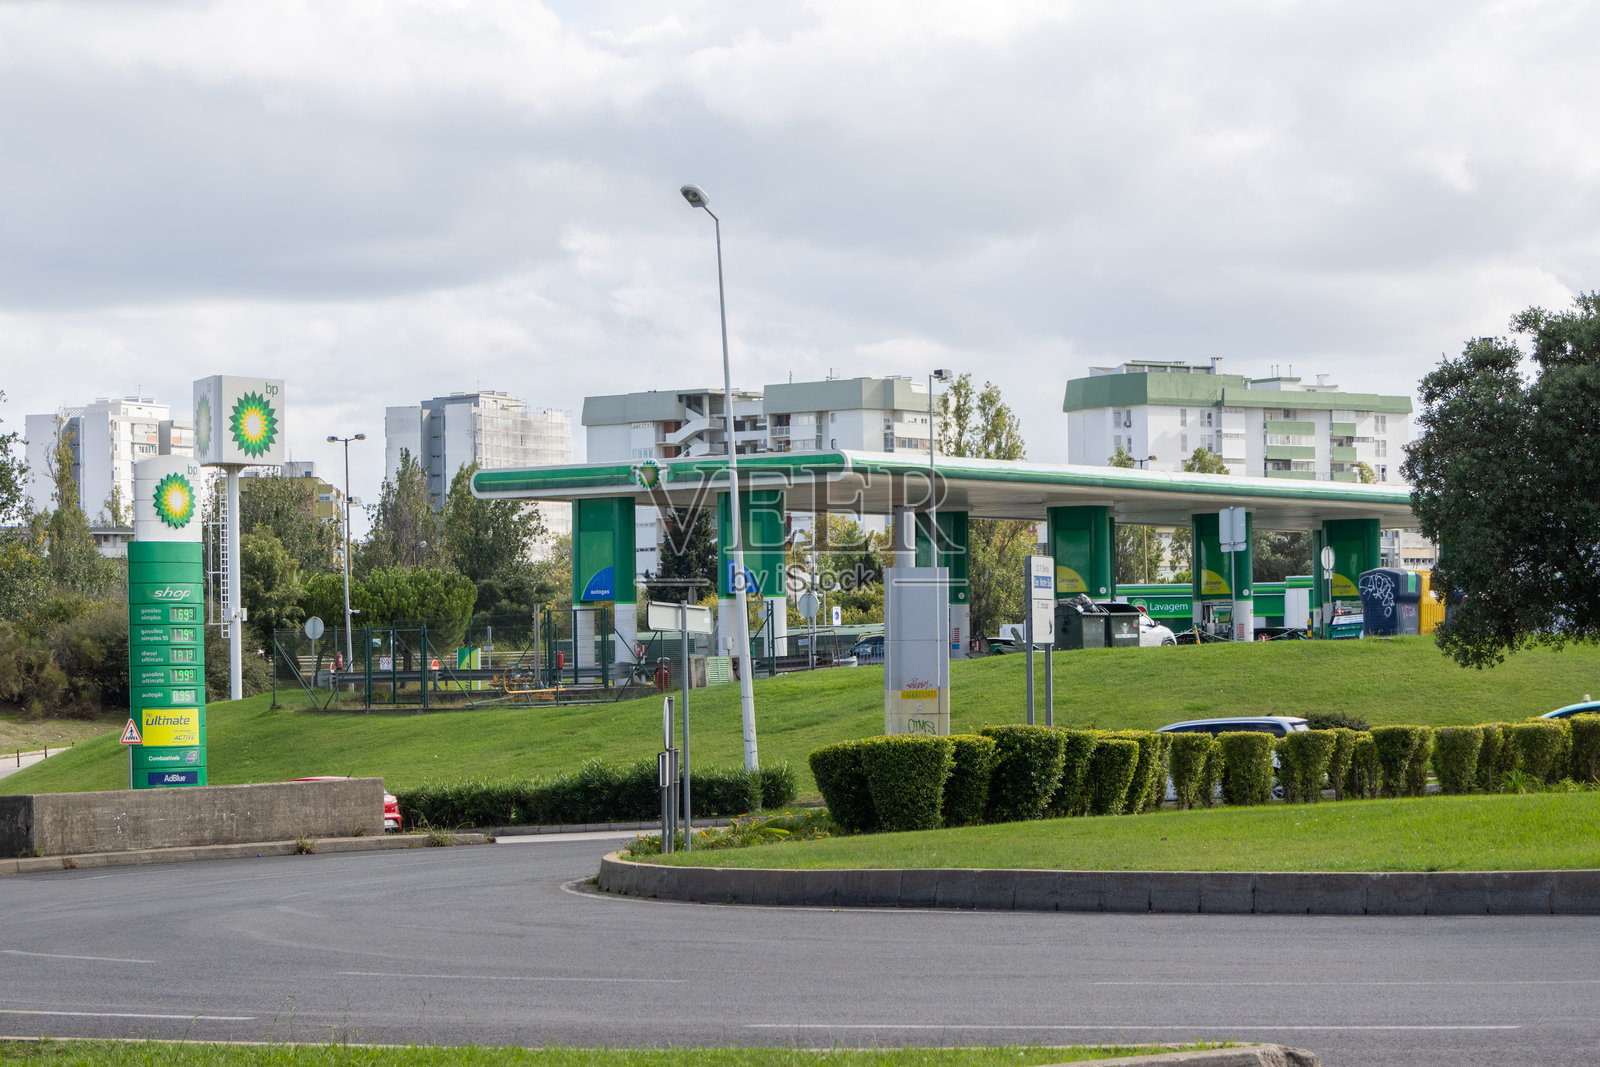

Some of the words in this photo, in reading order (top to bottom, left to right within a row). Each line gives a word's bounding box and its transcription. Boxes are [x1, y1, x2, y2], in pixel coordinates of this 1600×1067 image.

[265, 382, 278, 397] bp
[187, 464, 197, 477] bp
[154, 586, 191, 600] shop
[1149, 603, 1189, 612] Lavagem
[146, 715, 190, 726] ultimate
[164, 774, 186, 782] AdBlue
